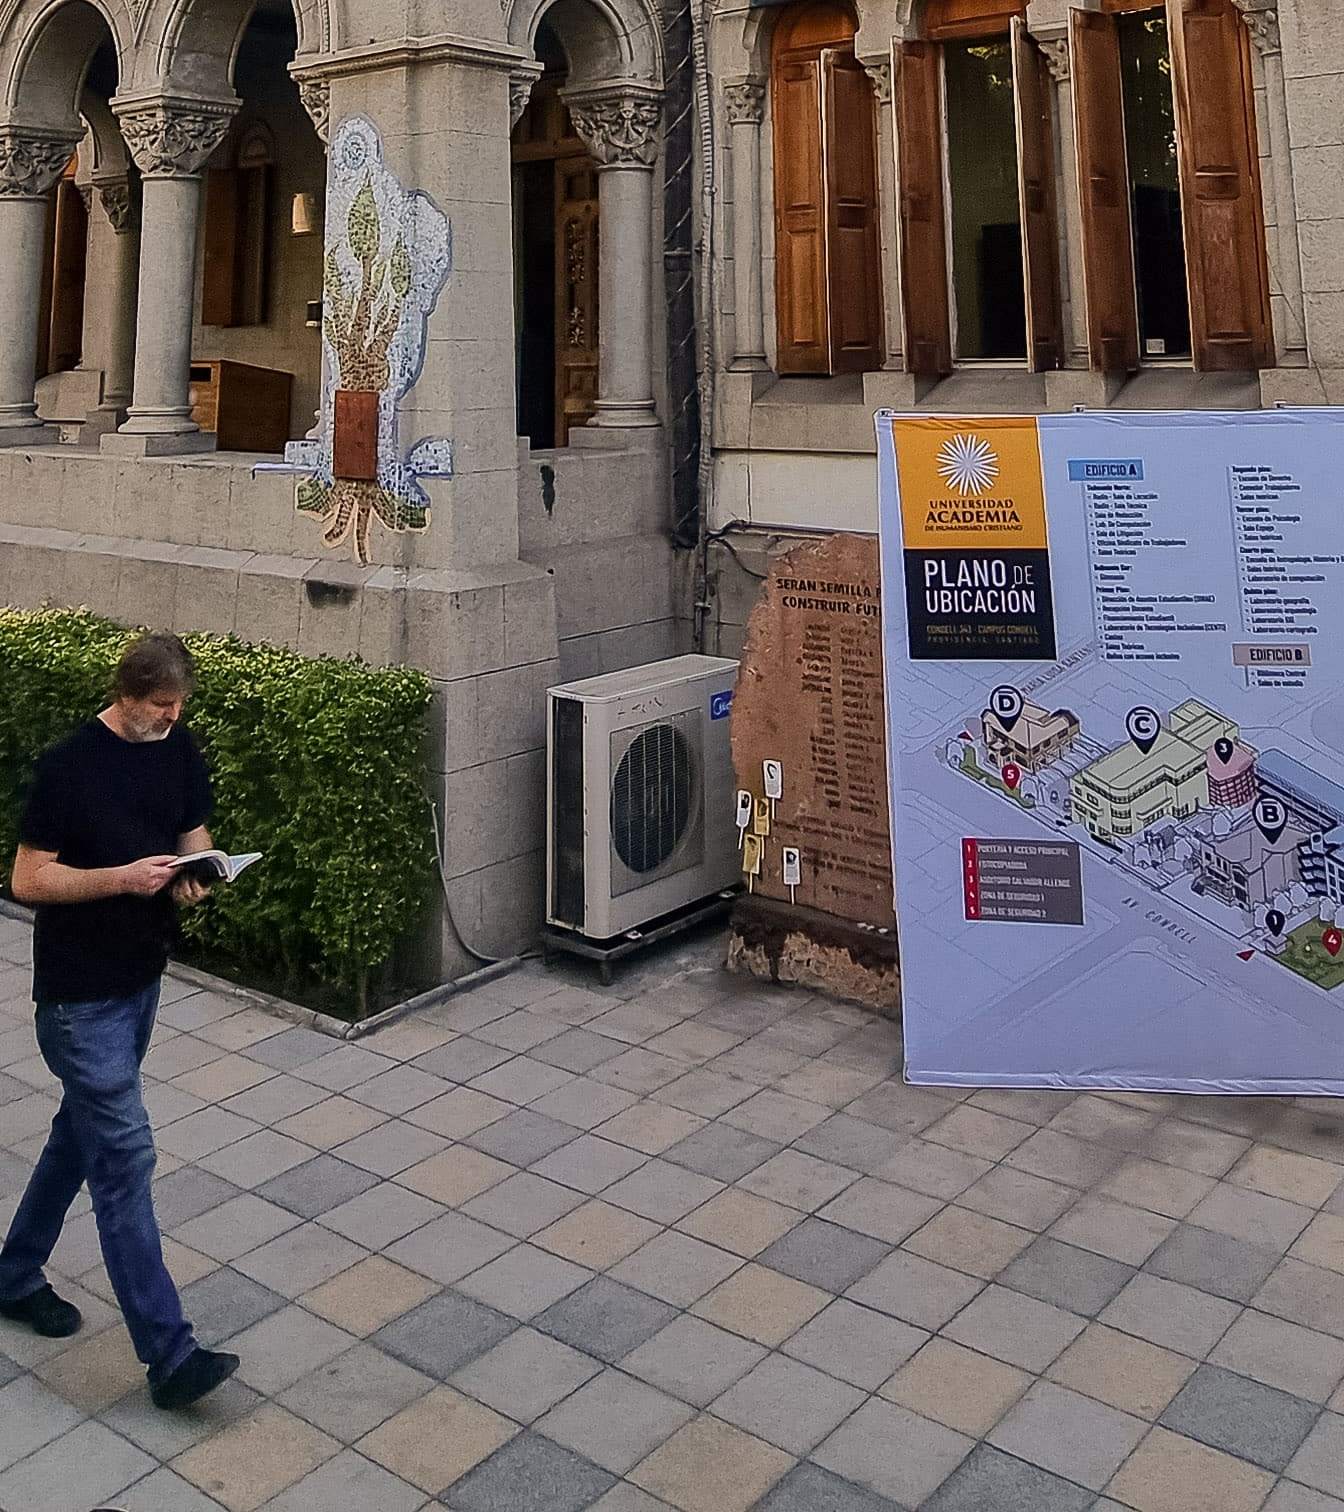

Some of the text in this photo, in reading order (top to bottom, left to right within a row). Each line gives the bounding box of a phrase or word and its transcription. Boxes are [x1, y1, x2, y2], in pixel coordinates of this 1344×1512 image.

[1085, 463, 1137, 477] EDIFICIO A
[929, 498, 1014, 510] UNIVERSIDAD
[925, 509, 1021, 524] ACADEMIA
[923, 559, 1035, 588] PLANO DE
[776, 577, 817, 593] SERAN
[818, 582, 871, 598] SEMILLA
[782, 595, 850, 614] CONSTRUIR
[924, 583, 1036, 614] UBICACIÓN
[1249, 648, 1303, 662] EDIFICIO B
[998, 694, 1015, 712] D
[1134, 715, 1151, 734] C
[1220, 742, 1229, 753] 3
[1007, 769, 1015, 779] 5
[1262, 805, 1279, 822] B
[1271, 914, 1278, 926] 1
[1327, 934, 1338, 946] 4
